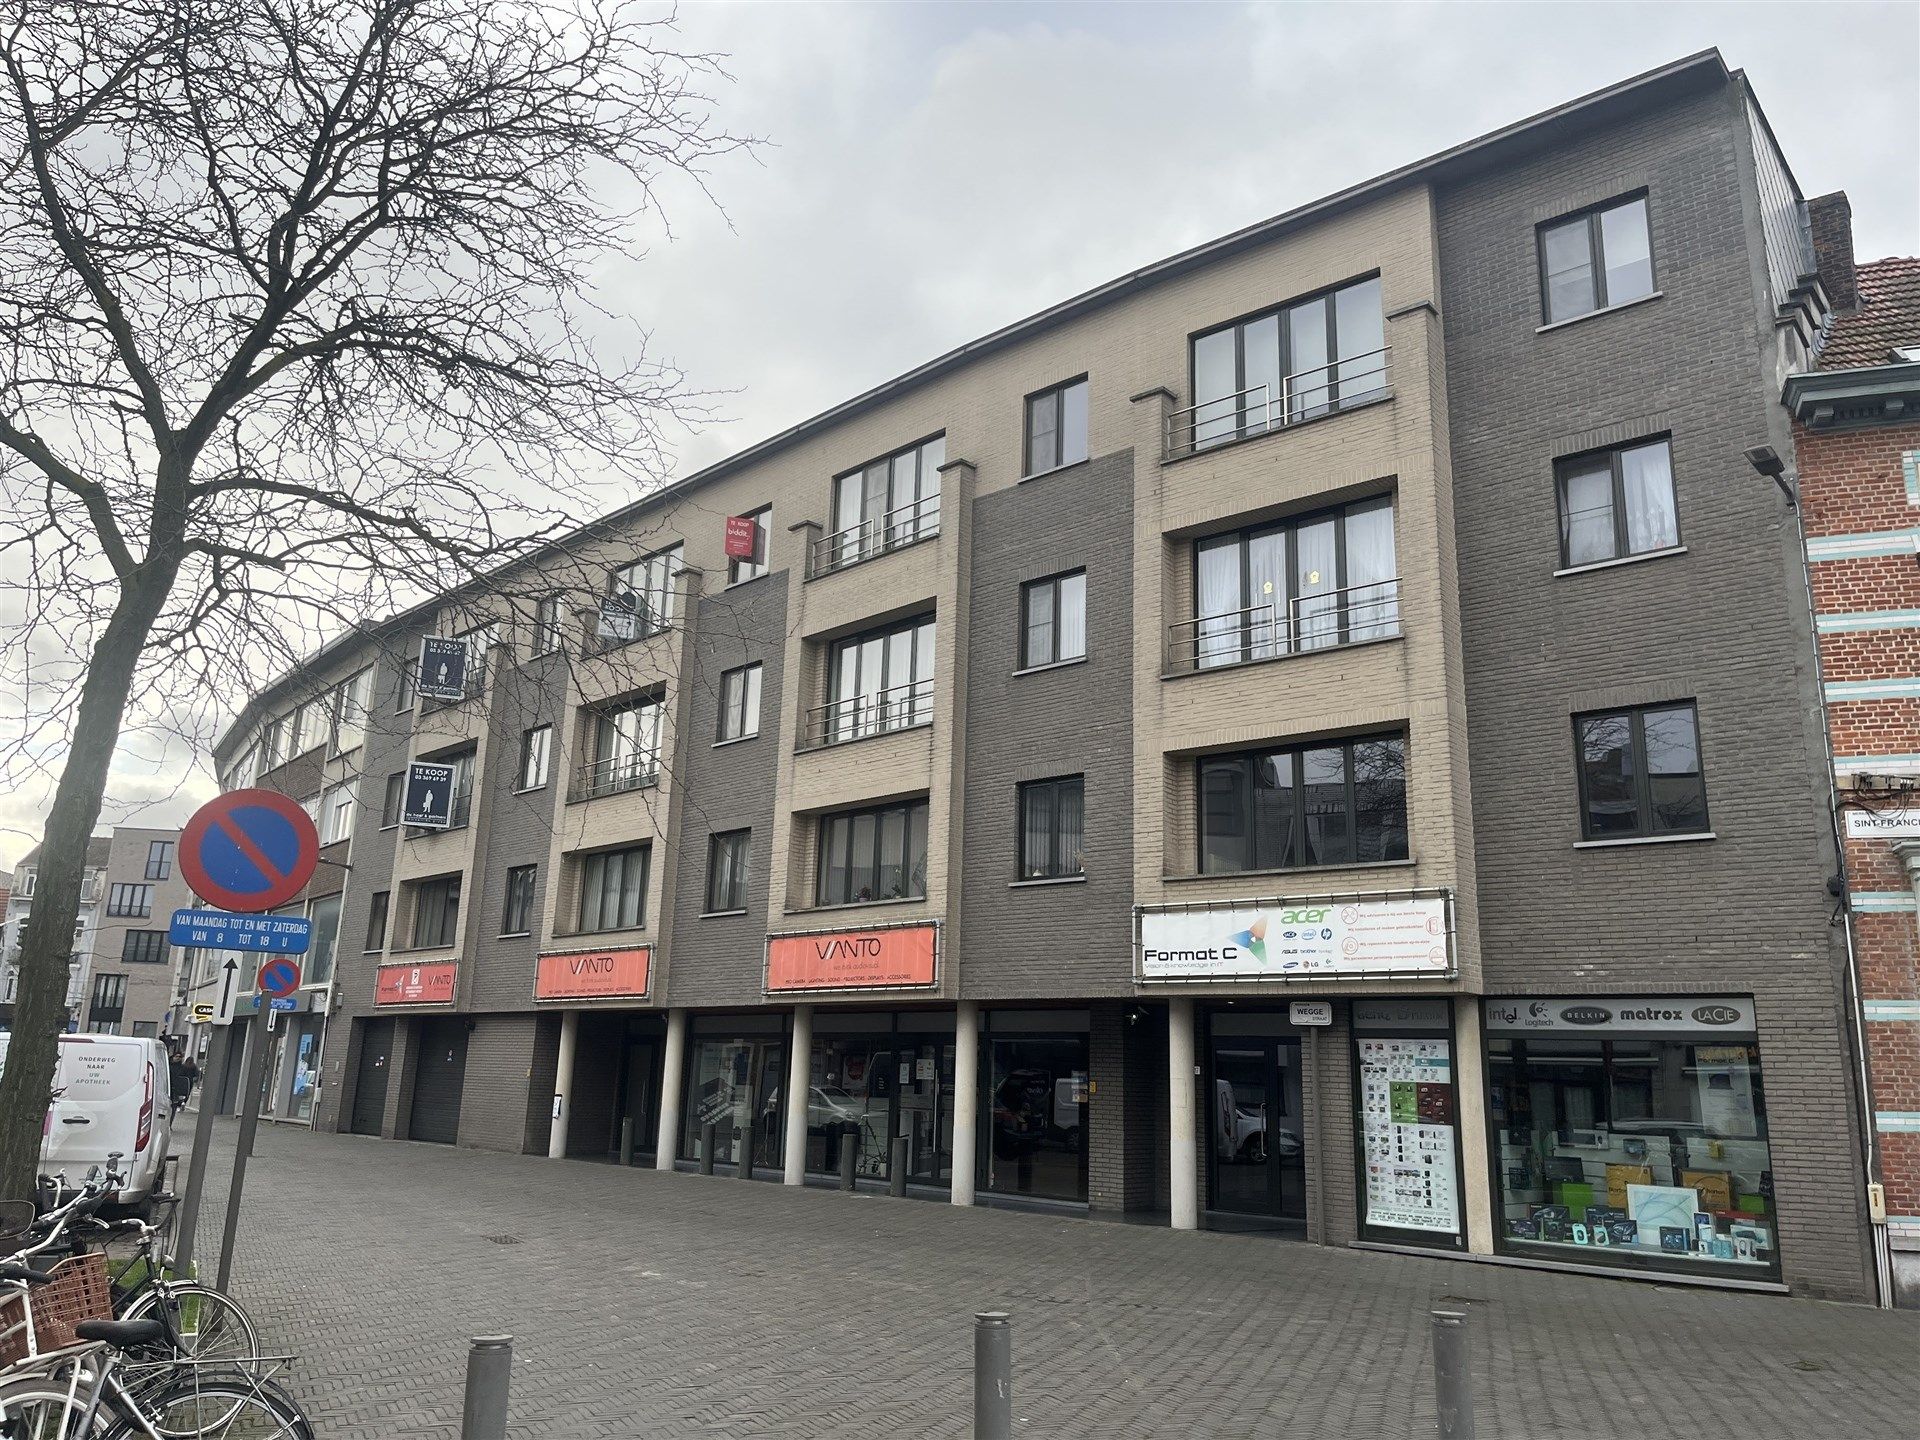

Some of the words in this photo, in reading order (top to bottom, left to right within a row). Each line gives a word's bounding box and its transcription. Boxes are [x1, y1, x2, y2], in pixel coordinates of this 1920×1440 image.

[426, 768, 448, 776] KOOP
[176, 914, 191, 926] VAN
[192, 916, 227, 928] MAANDAG
[230, 918, 243, 929] TOT
[245, 920, 254, 930] EN
[256, 922, 271, 932] MET
[272, 922, 308, 934] ZATERDAG
[1281, 909, 1331, 924] acer
[192, 930, 207, 941] VAN
[216, 932, 224, 943] 8
[238, 934, 252, 944] TOT
[260, 936, 270, 946] 18
[282, 938, 288, 947] U
[1144, 948, 1218, 961] Format
[1222, 948, 1237, 959] C
[1488, 1007, 1518, 1024] intel
[1525, 1019, 1553, 1027] Logitech
[1620, 1007, 1682, 1020] matrox
